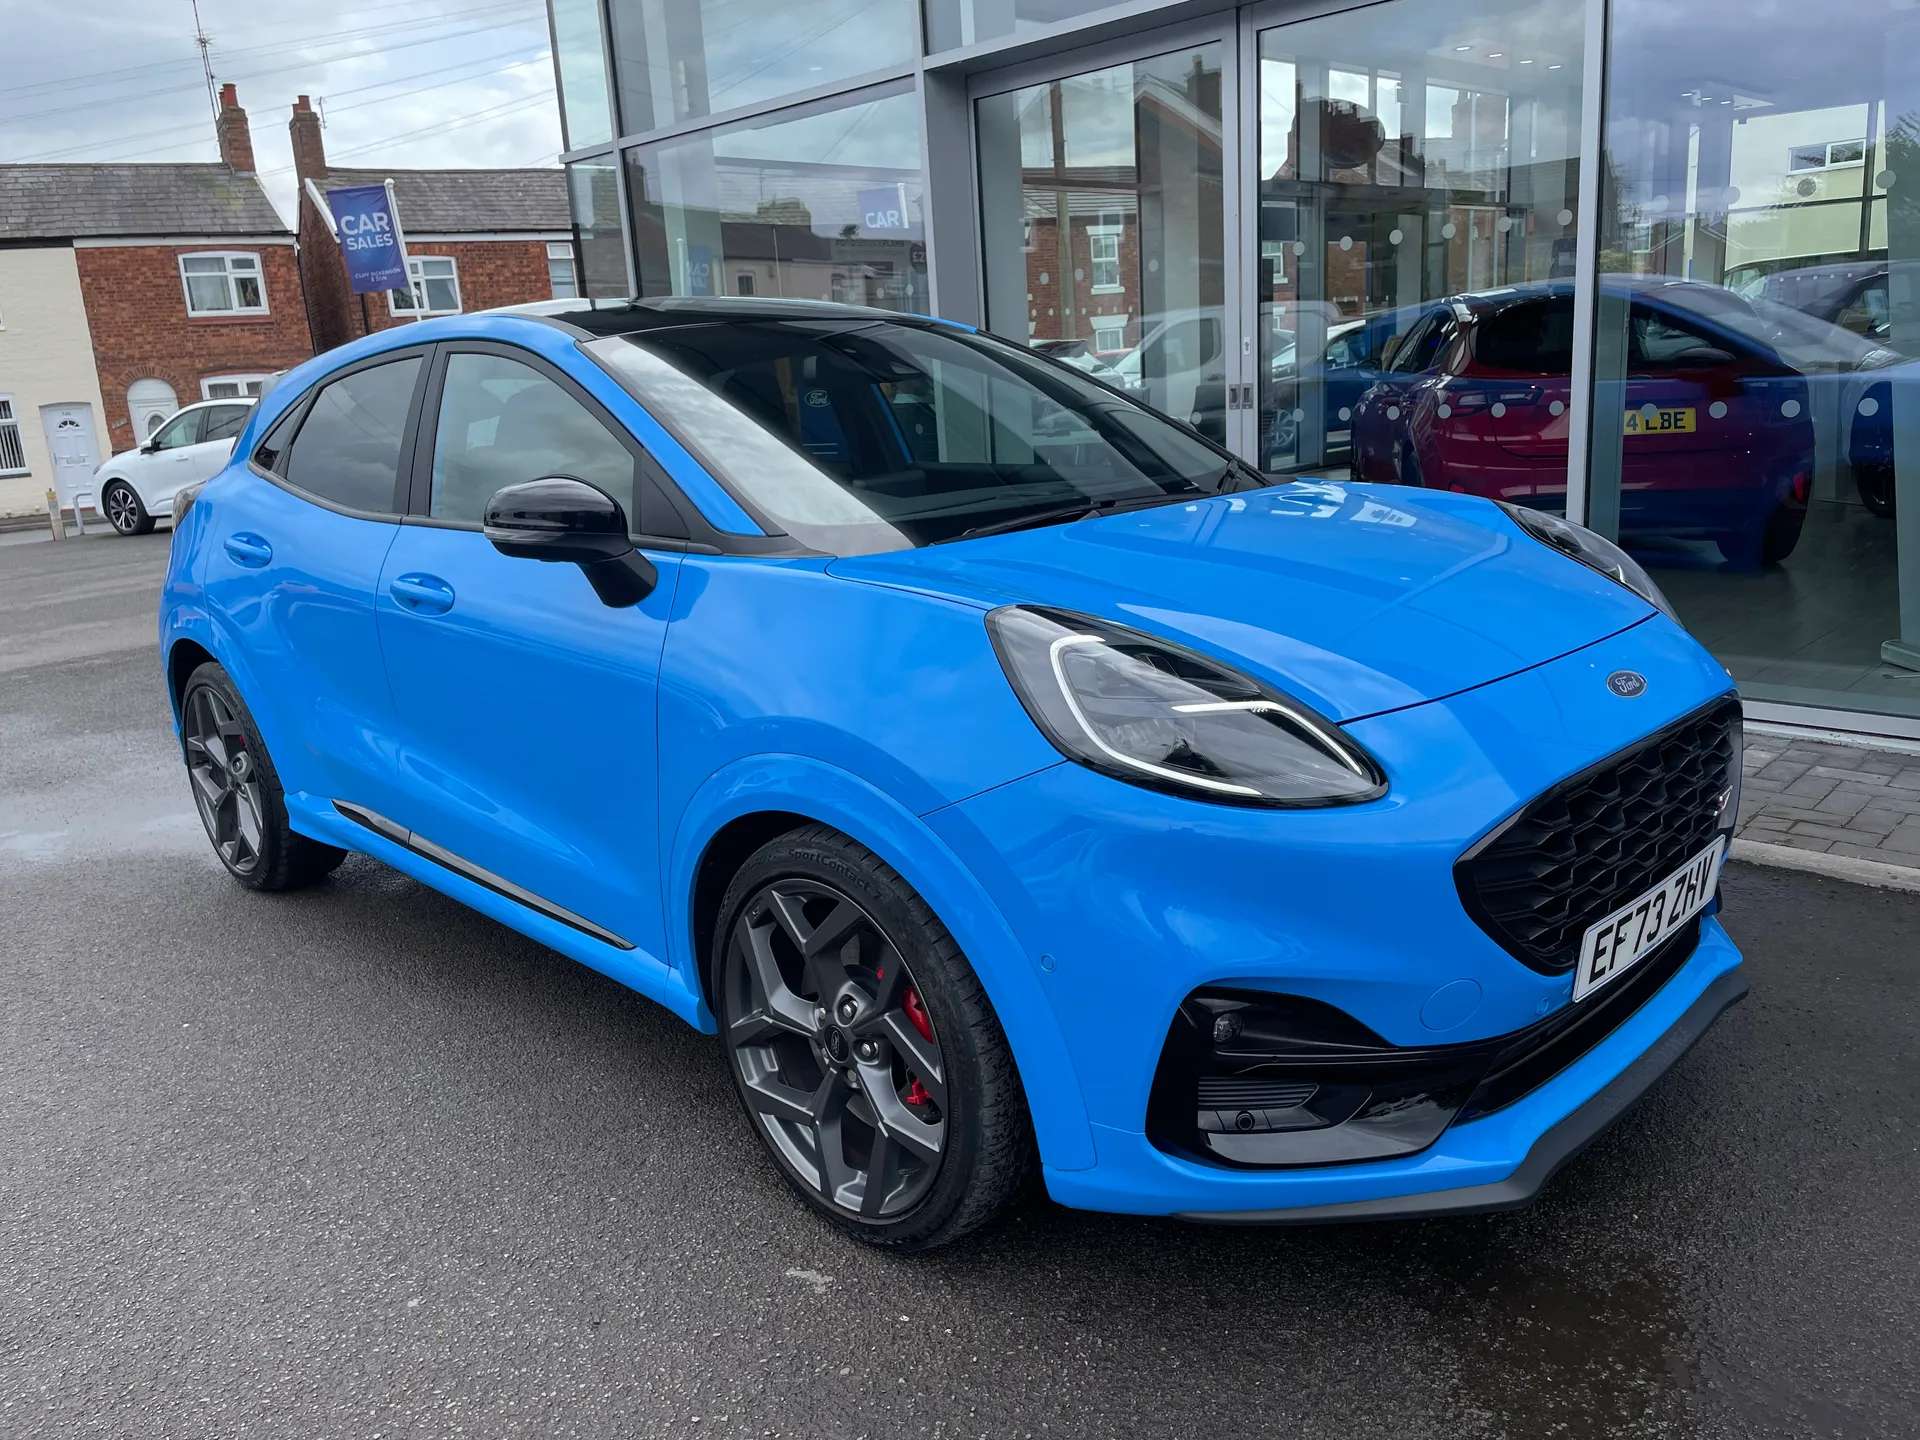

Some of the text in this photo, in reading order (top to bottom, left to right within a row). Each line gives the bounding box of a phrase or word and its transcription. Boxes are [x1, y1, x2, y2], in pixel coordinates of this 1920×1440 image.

[340, 212, 390, 235] CAR
[865, 210, 899, 228] CAR
[346, 233, 394, 250] SALES
[1645, 411, 1686, 430] LBE
[1615, 676, 1641, 693] Ford
[788, 848, 871, 890] SportContact
[1589, 850, 1716, 984] EF73 ZHV
